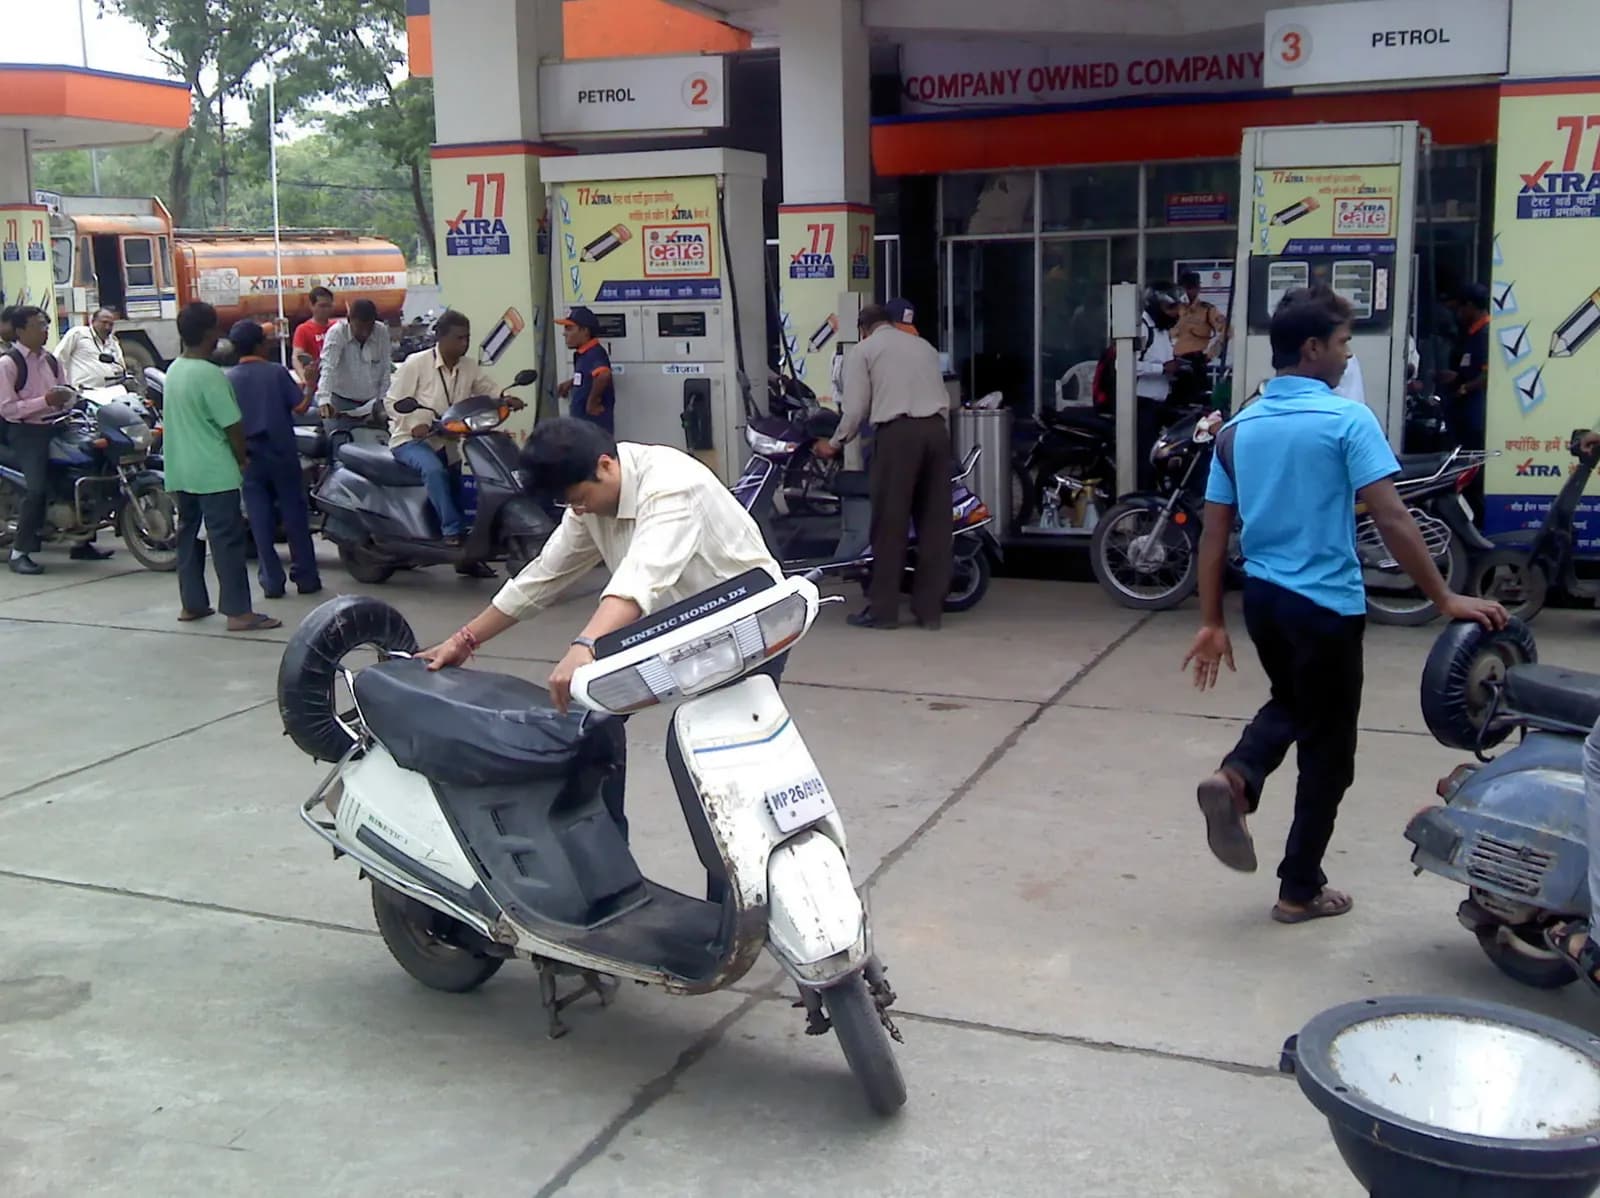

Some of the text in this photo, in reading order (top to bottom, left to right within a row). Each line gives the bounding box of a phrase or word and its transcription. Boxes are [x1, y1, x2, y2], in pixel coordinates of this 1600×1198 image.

[1281, 28, 1450, 62] 3 PETROL
[906, 51, 1264, 100] COMPANY OWNED COMPANY
[577, 78, 708, 105] PETROL 2
[1272, 171, 1285, 183] 77
[466, 172, 505, 218] 77
[577, 188, 590, 206] 77
[591, 188, 612, 205] XTRA
[672, 204, 693, 220] XTRA
[1354, 201, 1385, 211] XTRA
[446, 209, 508, 236] XTRA
[1339, 211, 1385, 224] care
[665, 230, 703, 243] XTRA
[807, 224, 835, 253] 77
[650, 243, 704, 260] care
[790, 247, 833, 265] XTRA
[1516, 458, 1561, 477] XTRA
[620, 586, 747, 647] KINETIC HONDA DX
